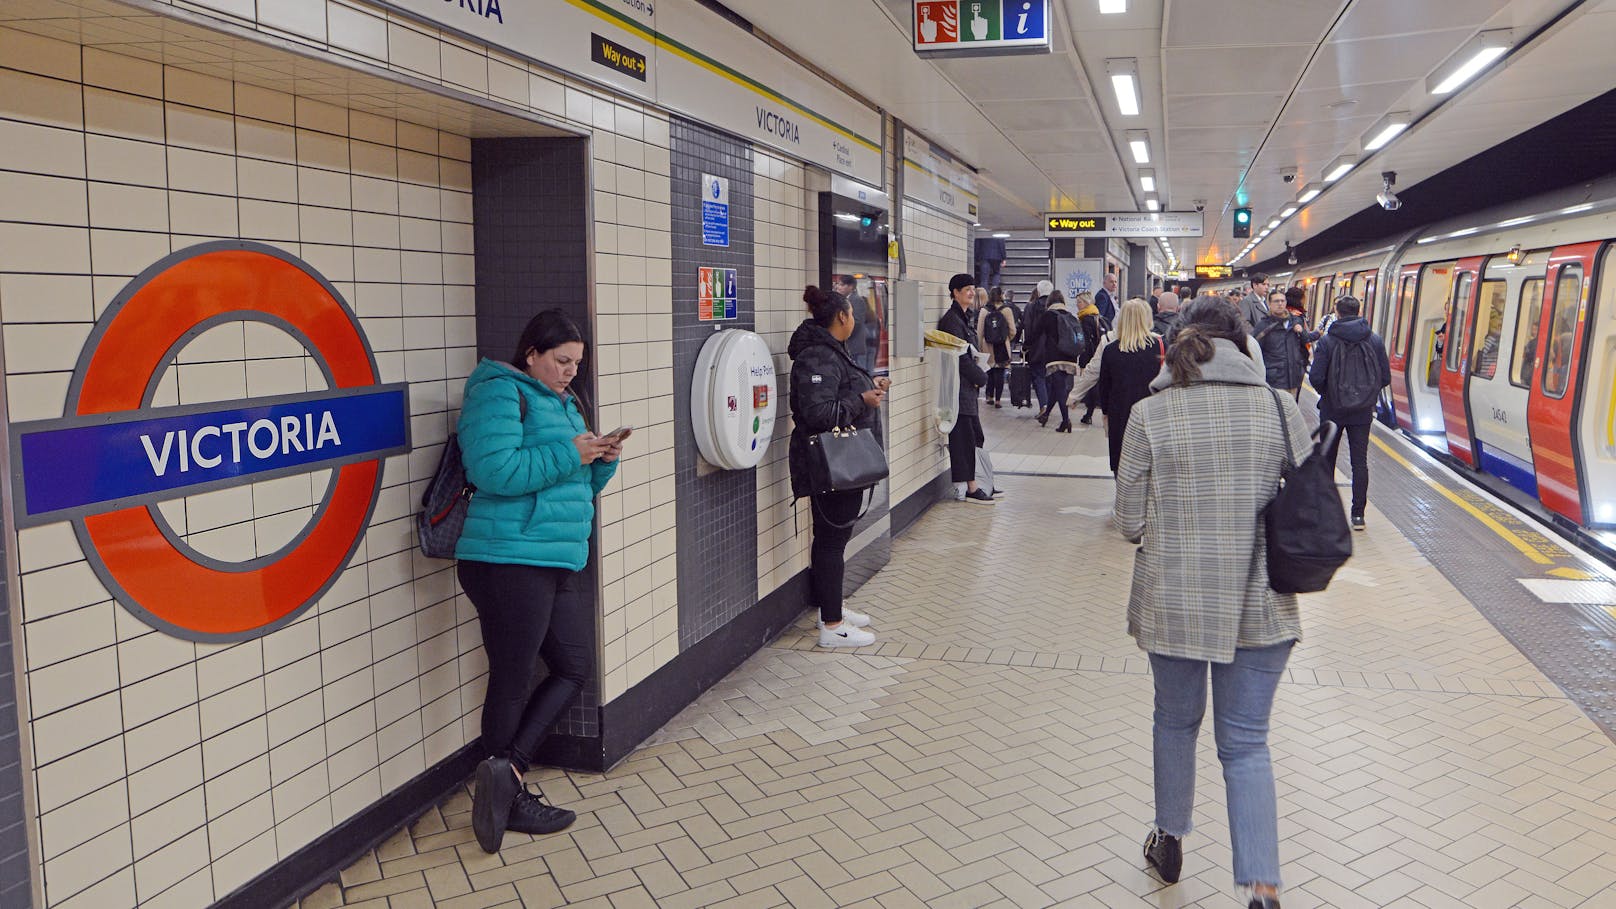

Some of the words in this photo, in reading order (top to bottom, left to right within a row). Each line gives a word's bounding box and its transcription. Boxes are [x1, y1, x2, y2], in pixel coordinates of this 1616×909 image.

[602, 42, 621, 67] Way
[622, 55, 637, 71] out
[756, 106, 800, 144] VICTORIA
[1060, 219, 1078, 230] Way
[1079, 219, 1095, 228] out
[1070, 278, 1088, 289] ONLY
[751, 366, 763, 380] Help
[140, 410, 342, 477] VICTORIA
